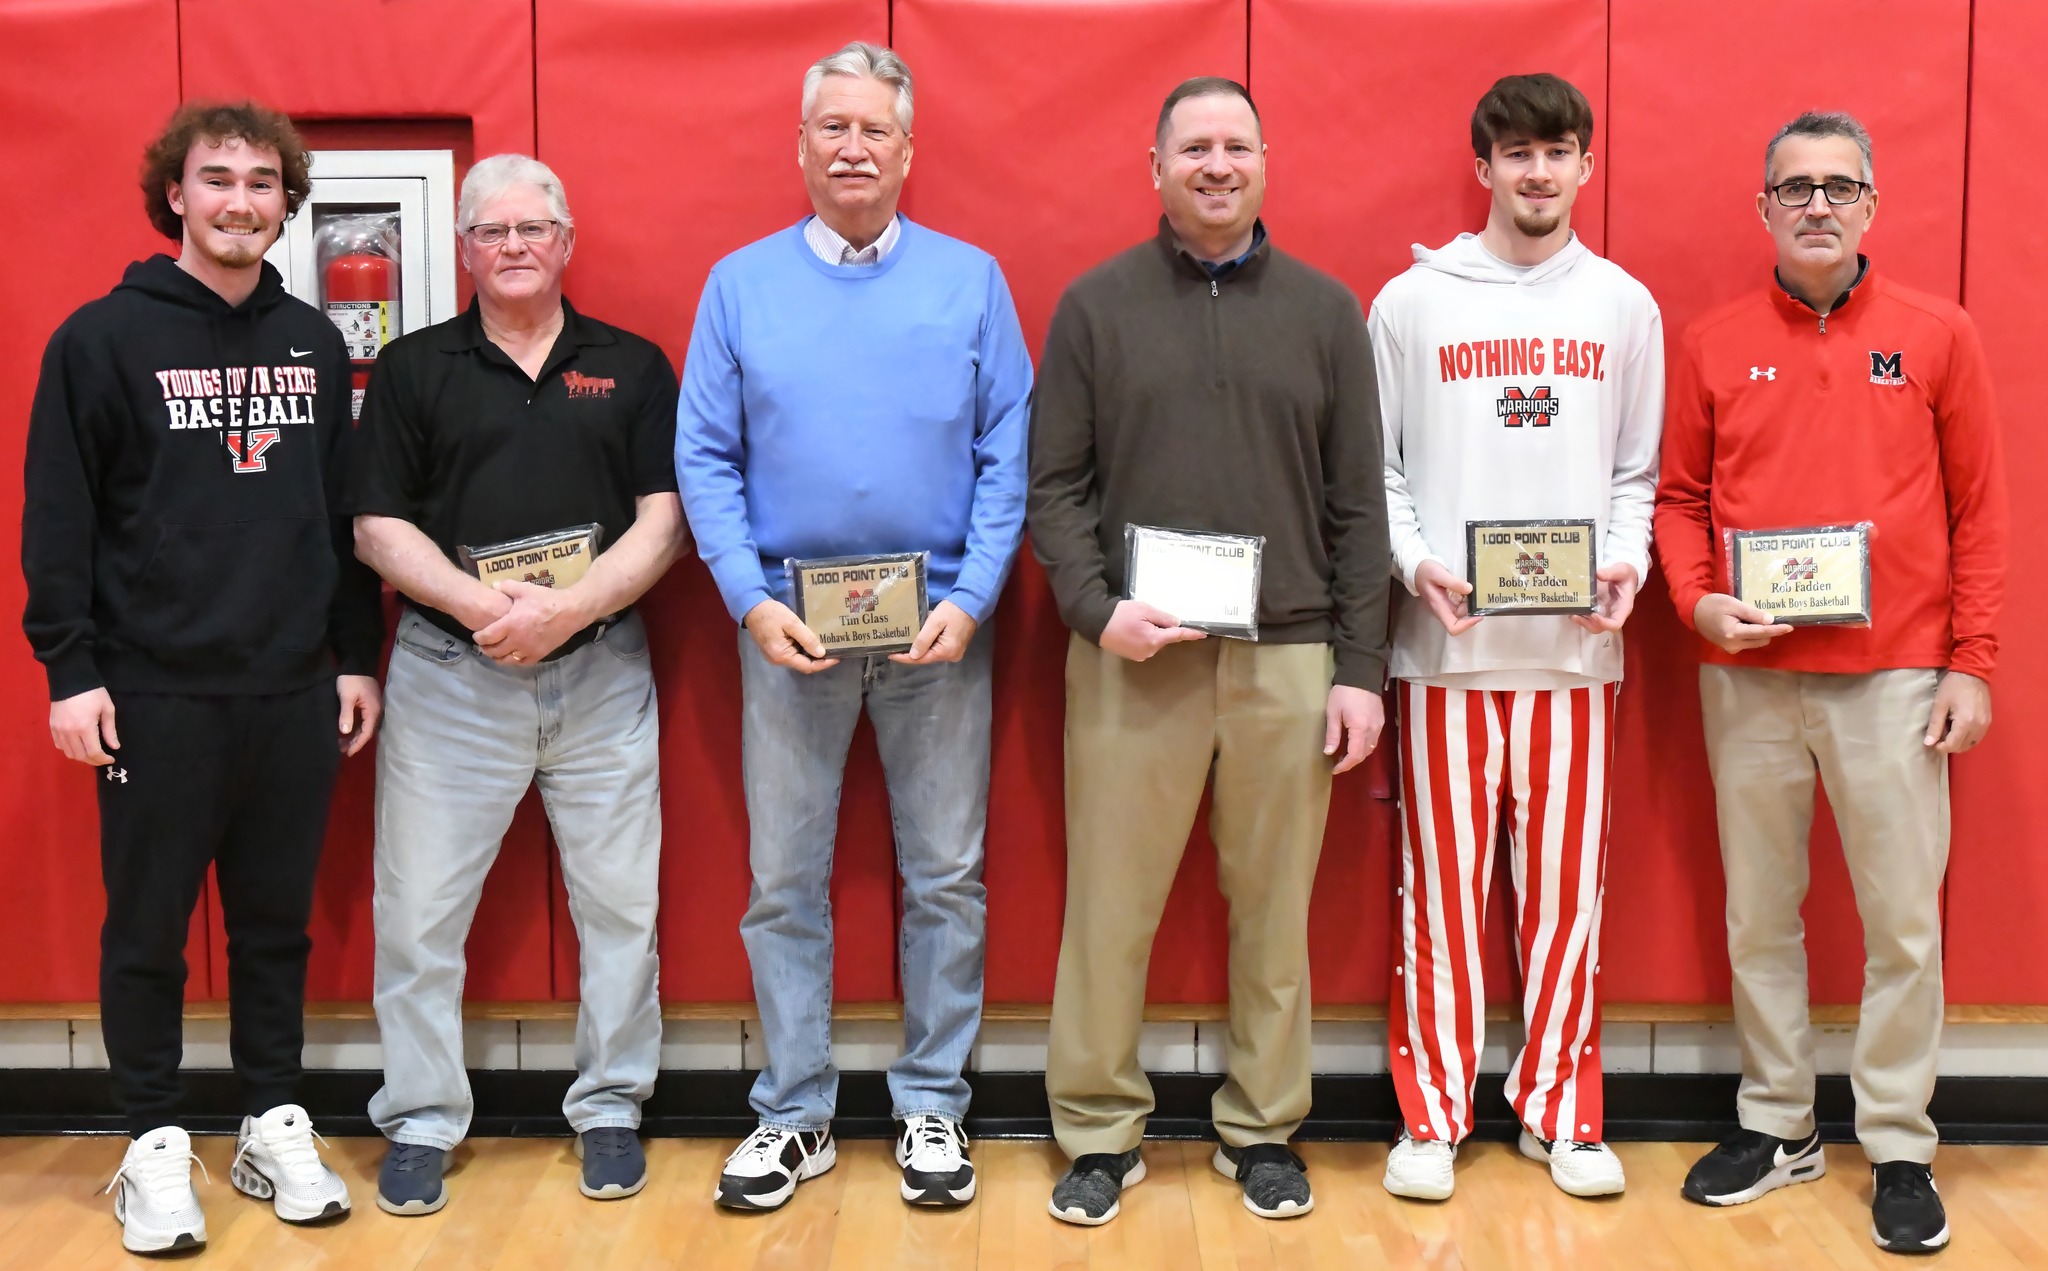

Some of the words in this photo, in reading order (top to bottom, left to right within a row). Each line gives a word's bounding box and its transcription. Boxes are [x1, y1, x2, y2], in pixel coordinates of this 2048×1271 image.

[1439, 337, 1545, 382] NOTHING
[1553, 338, 1605, 381] EASY.
[1869, 350, 1903, 378] M
[273, 366, 317, 395] STATE
[1497, 398, 1559, 417] WARRIORS
[219, 427, 281, 473] Y
[1515, 533, 1547, 544] POINT
[1551, 532, 1580, 544] CLUB
[1783, 539, 1816, 550] POINT
[1821, 537, 1851, 547] CLUB
[518, 551, 549, 567] POINT
[552, 544, 581, 559] CLUB
[1216, 547, 1245, 558] CLUB
[843, 570, 876, 583] POINT
[1499, 578, 1530, 591] Bobby
[1533, 576, 1568, 587] Fadden
[1772, 583, 1792, 593] Rob
[1795, 581, 1832, 592] Fadden
[1487, 593, 1519, 604] Mohawk
[1540, 591, 1579, 603] Basketball
[1754, 598, 1786, 610] Mohawk
[1789, 599, 1808, 611] Boys
[1809, 595, 1850, 608] Basketball
[839, 615, 860, 627] Tim
[862, 613, 889, 625] Glass
[819, 633, 851, 644] Mohawk
[853, 632, 871, 644] Boys
[872, 626, 910, 639] Basketball
